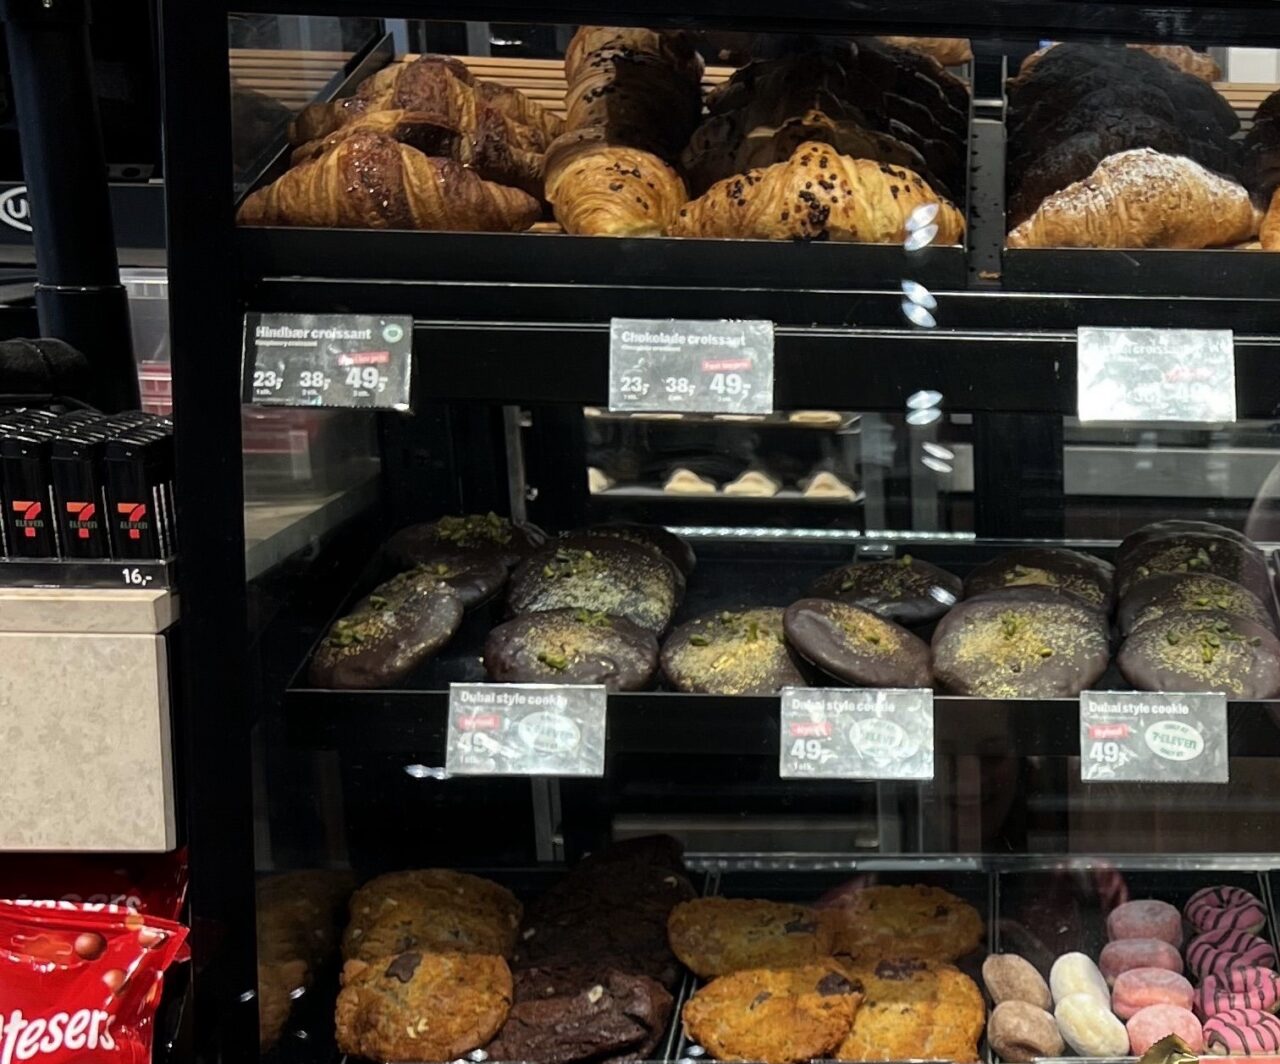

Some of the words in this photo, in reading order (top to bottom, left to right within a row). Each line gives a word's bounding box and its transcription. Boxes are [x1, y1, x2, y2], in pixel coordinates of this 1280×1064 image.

[311, 328, 372, 340] croissant
[622, 331, 686, 344] Chokolade
[122, 568, 152, 586] 16,-
[461, 691, 495, 705] Dubai
[497, 691, 526, 706] style
[827, 700, 855, 714] style
[1089, 700, 1123, 713] Dubai
[1123, 701, 1150, 716] style
[1151, 702, 1189, 716] cookie
